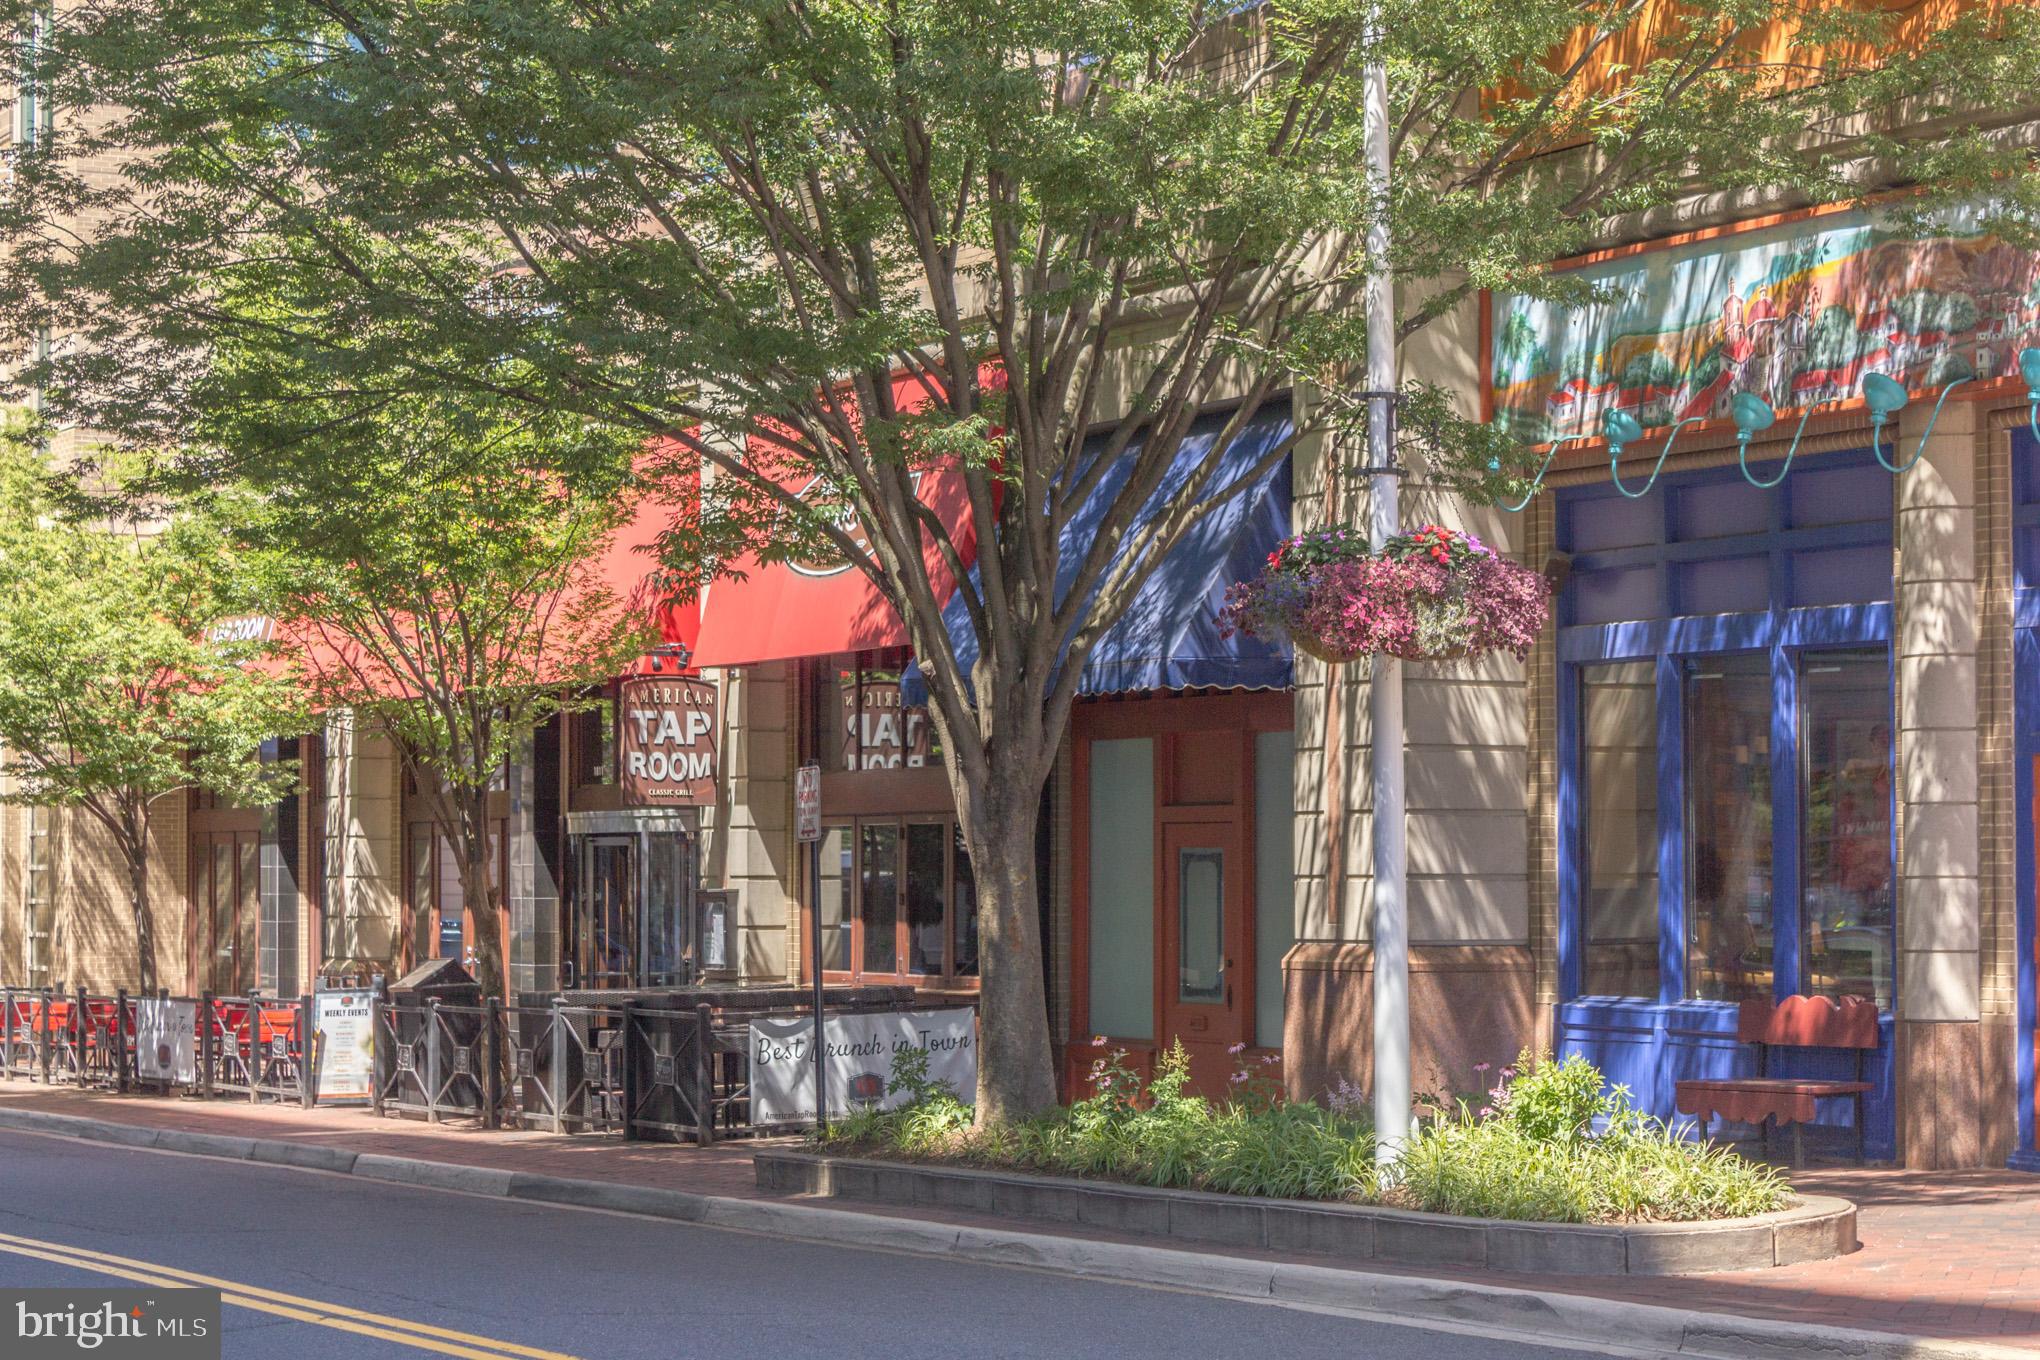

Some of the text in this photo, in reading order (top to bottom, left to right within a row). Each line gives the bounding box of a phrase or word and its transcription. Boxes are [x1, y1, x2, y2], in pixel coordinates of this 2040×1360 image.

[628, 687, 714, 705] AMERICAN
[629, 709, 713, 747] TAP
[628, 751, 711, 782] ROOM
[648, 788, 694, 798] CLASSIC GRILL
[325, 1008, 369, 1017] WEEKLY EVENTS
[757, 1030, 972, 1066] Best runch in Town
